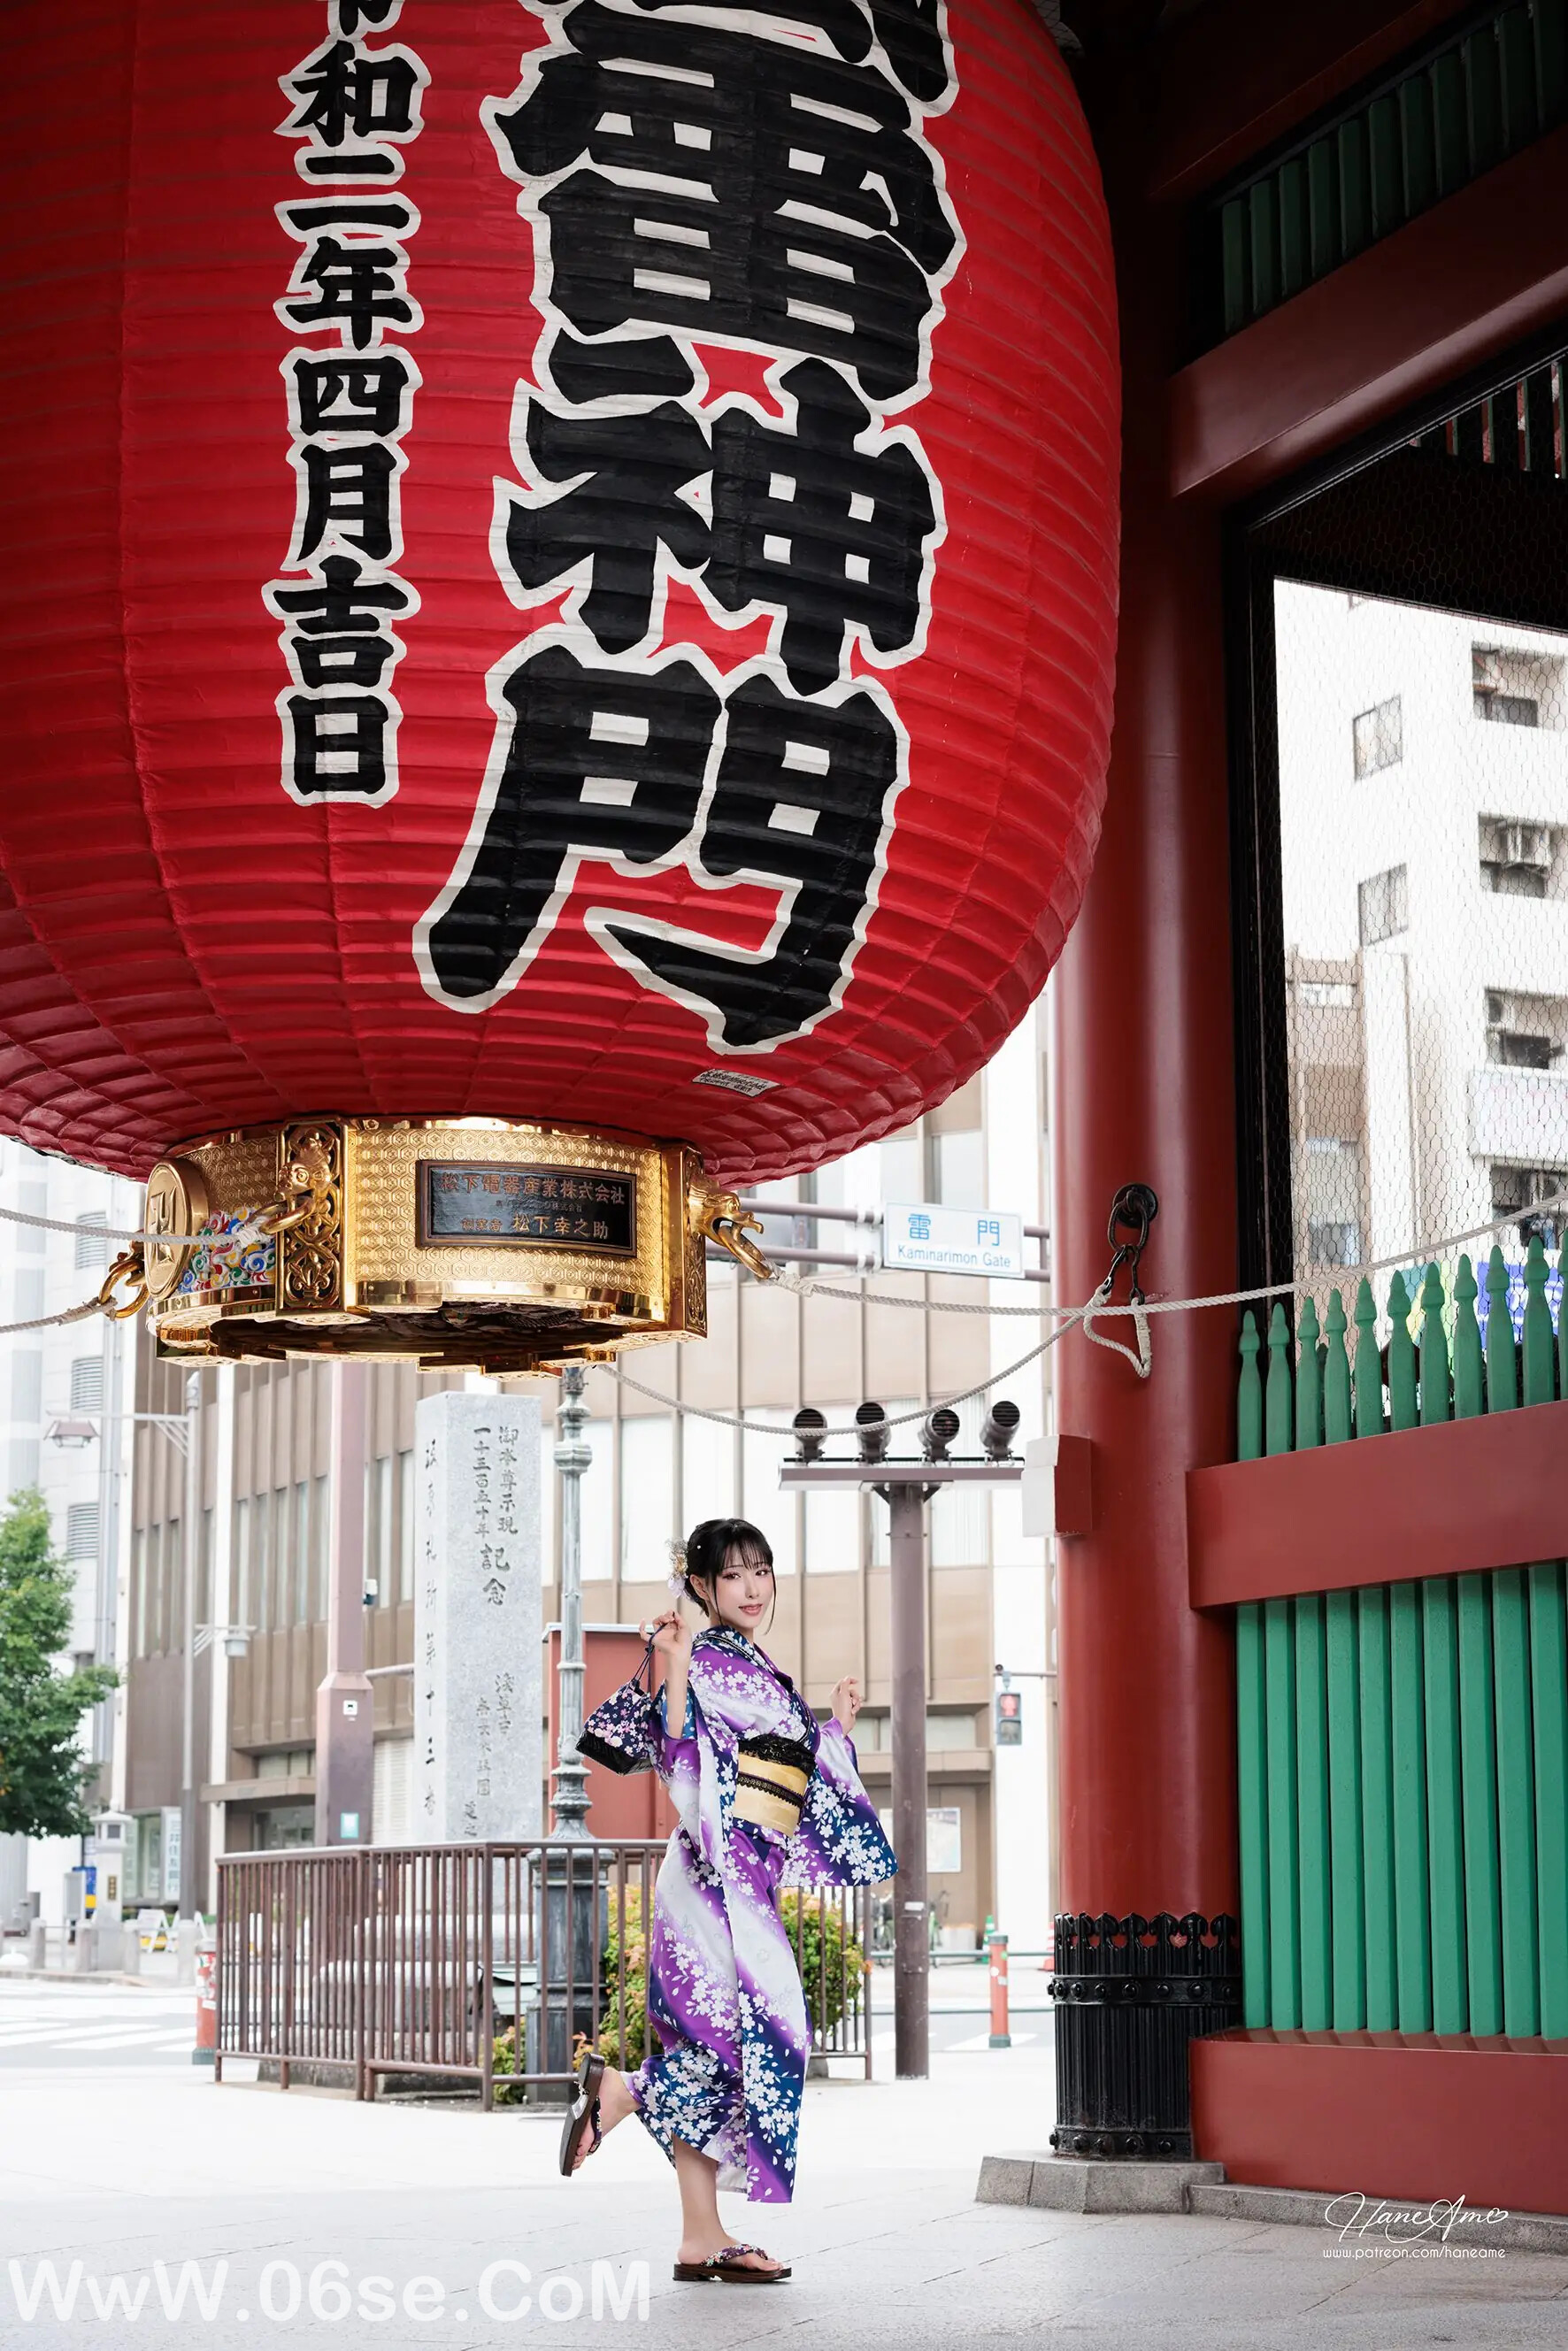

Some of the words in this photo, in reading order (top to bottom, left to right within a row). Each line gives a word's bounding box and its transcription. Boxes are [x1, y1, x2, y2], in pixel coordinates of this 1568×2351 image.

[439, 1172, 626, 1205] 松下電器産業株式会社
[512, 1210, 610, 1240] 松下幸之助
[908, 1213, 1001, 1247] 雷門
[897, 1244, 978, 1266] Kaminarimon
[982, 1251, 1011, 1268] Gate
[480, 1542, 511, 1606] 記念
